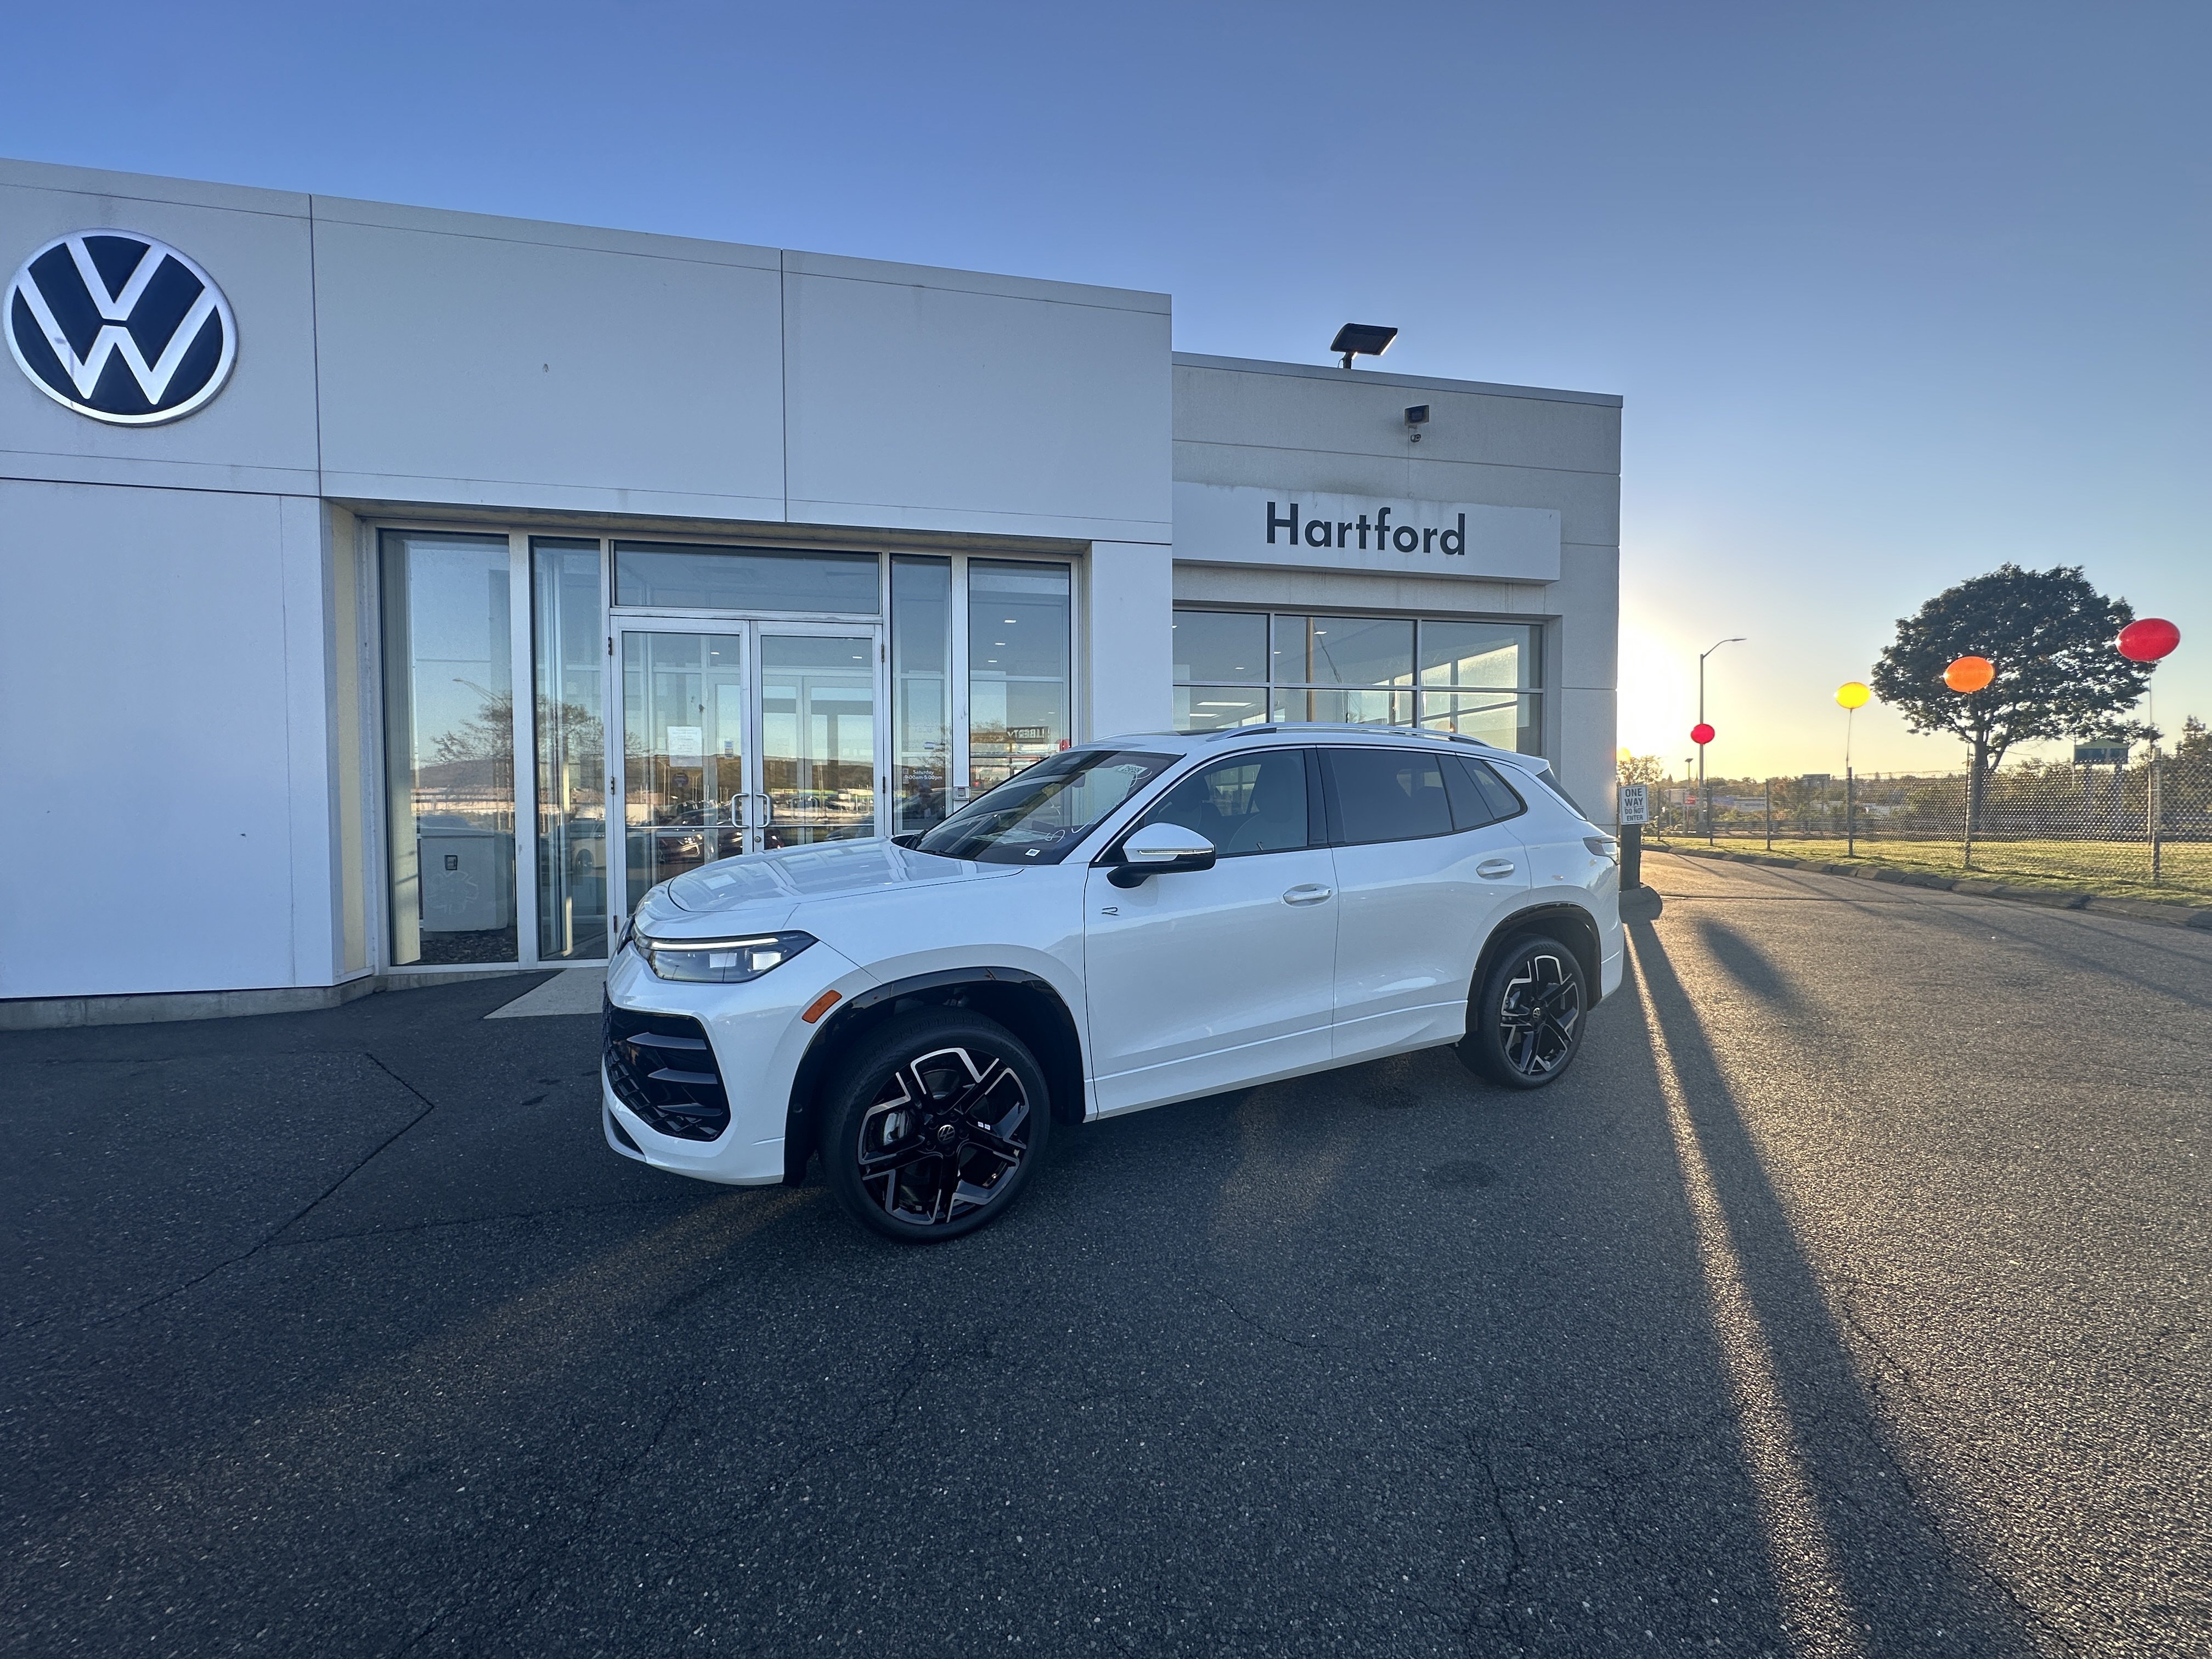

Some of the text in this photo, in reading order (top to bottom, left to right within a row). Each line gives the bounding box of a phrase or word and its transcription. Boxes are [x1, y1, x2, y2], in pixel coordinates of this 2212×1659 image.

[11, 235, 226, 409] VW
[1267, 501, 1465, 555] Hartford
[1624, 797, 1644, 806] WAY
[1625, 788, 1643, 797] ONE
